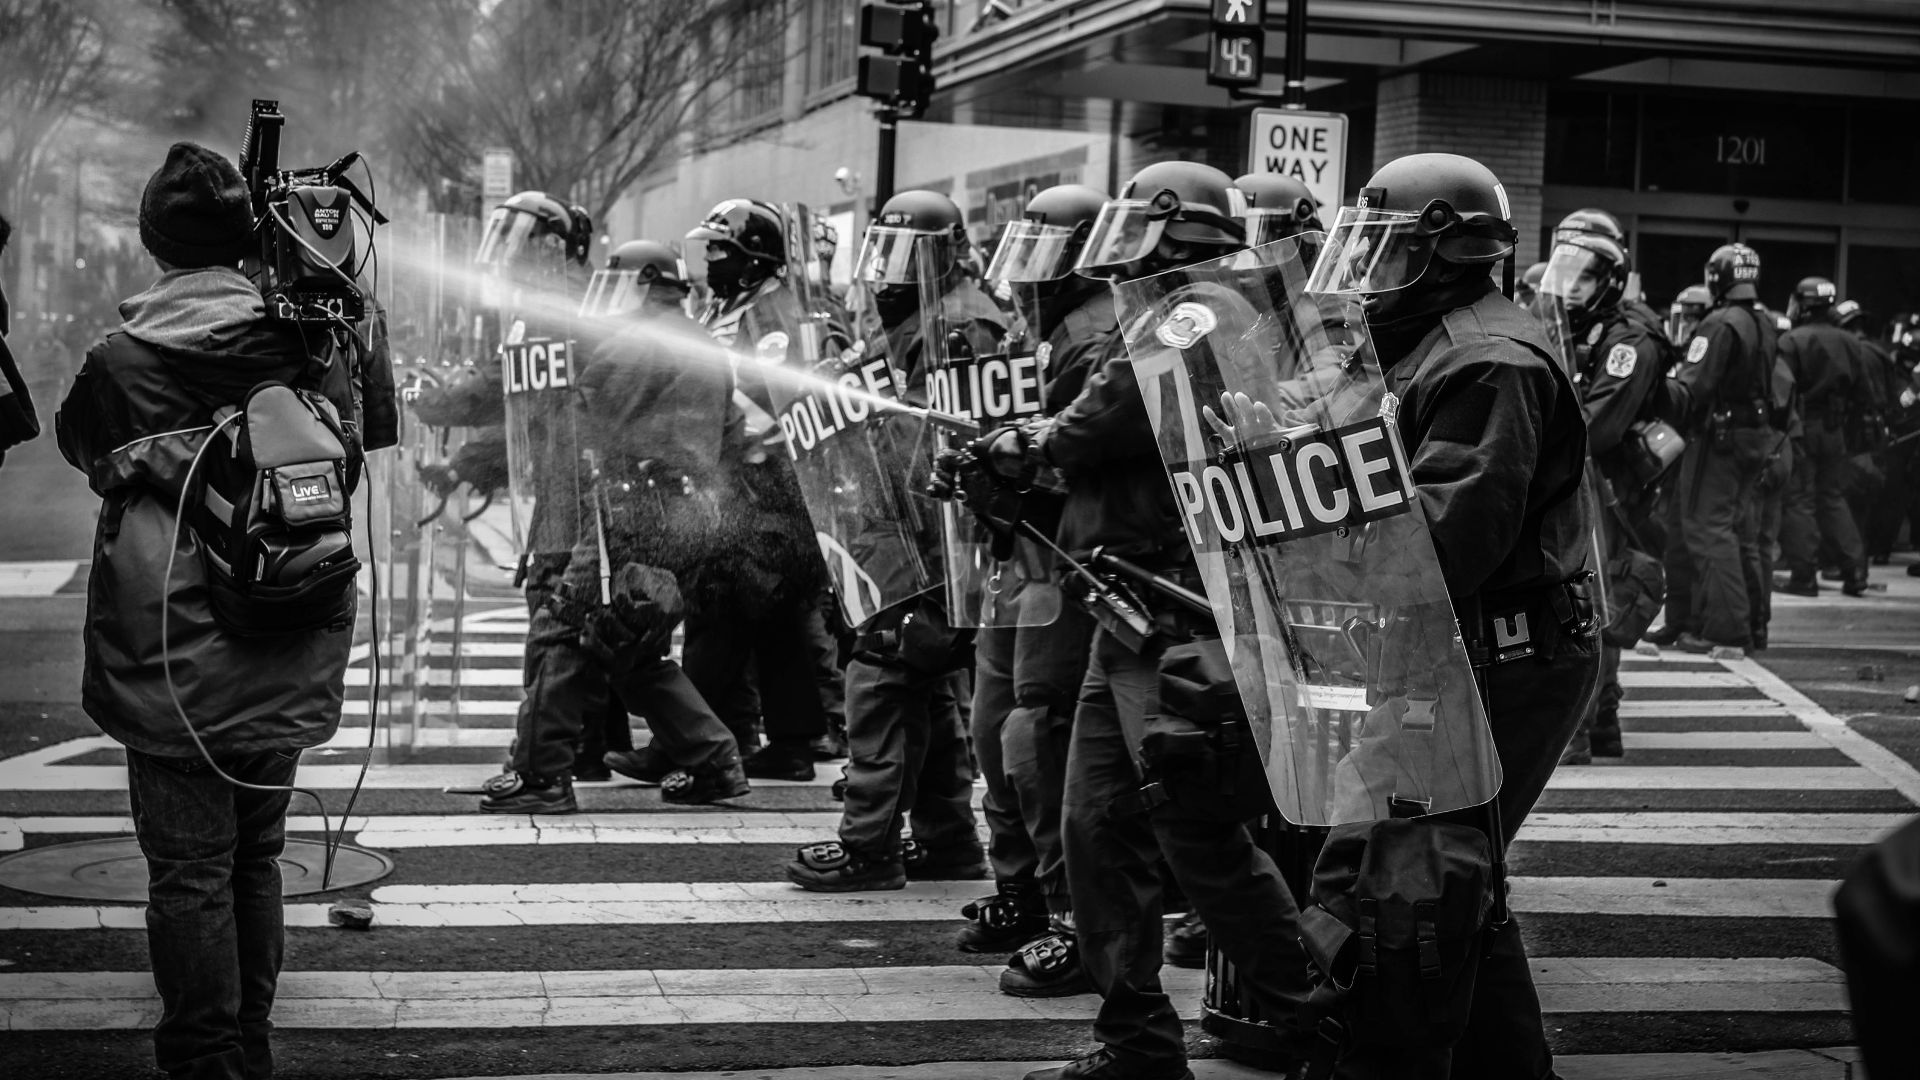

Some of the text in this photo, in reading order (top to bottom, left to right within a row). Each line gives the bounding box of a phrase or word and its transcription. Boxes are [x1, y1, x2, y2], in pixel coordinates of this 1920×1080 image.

[1221, 37, 1252, 77] 45
[1270, 125, 1328, 153] ONE
[1717, 136, 1765, 165] 1201
[1266, 155, 1328, 184] WAY
[926, 357, 1040, 419] POLICE
[780, 358, 898, 461] POLICE
[1173, 426, 1403, 545] POLICE
